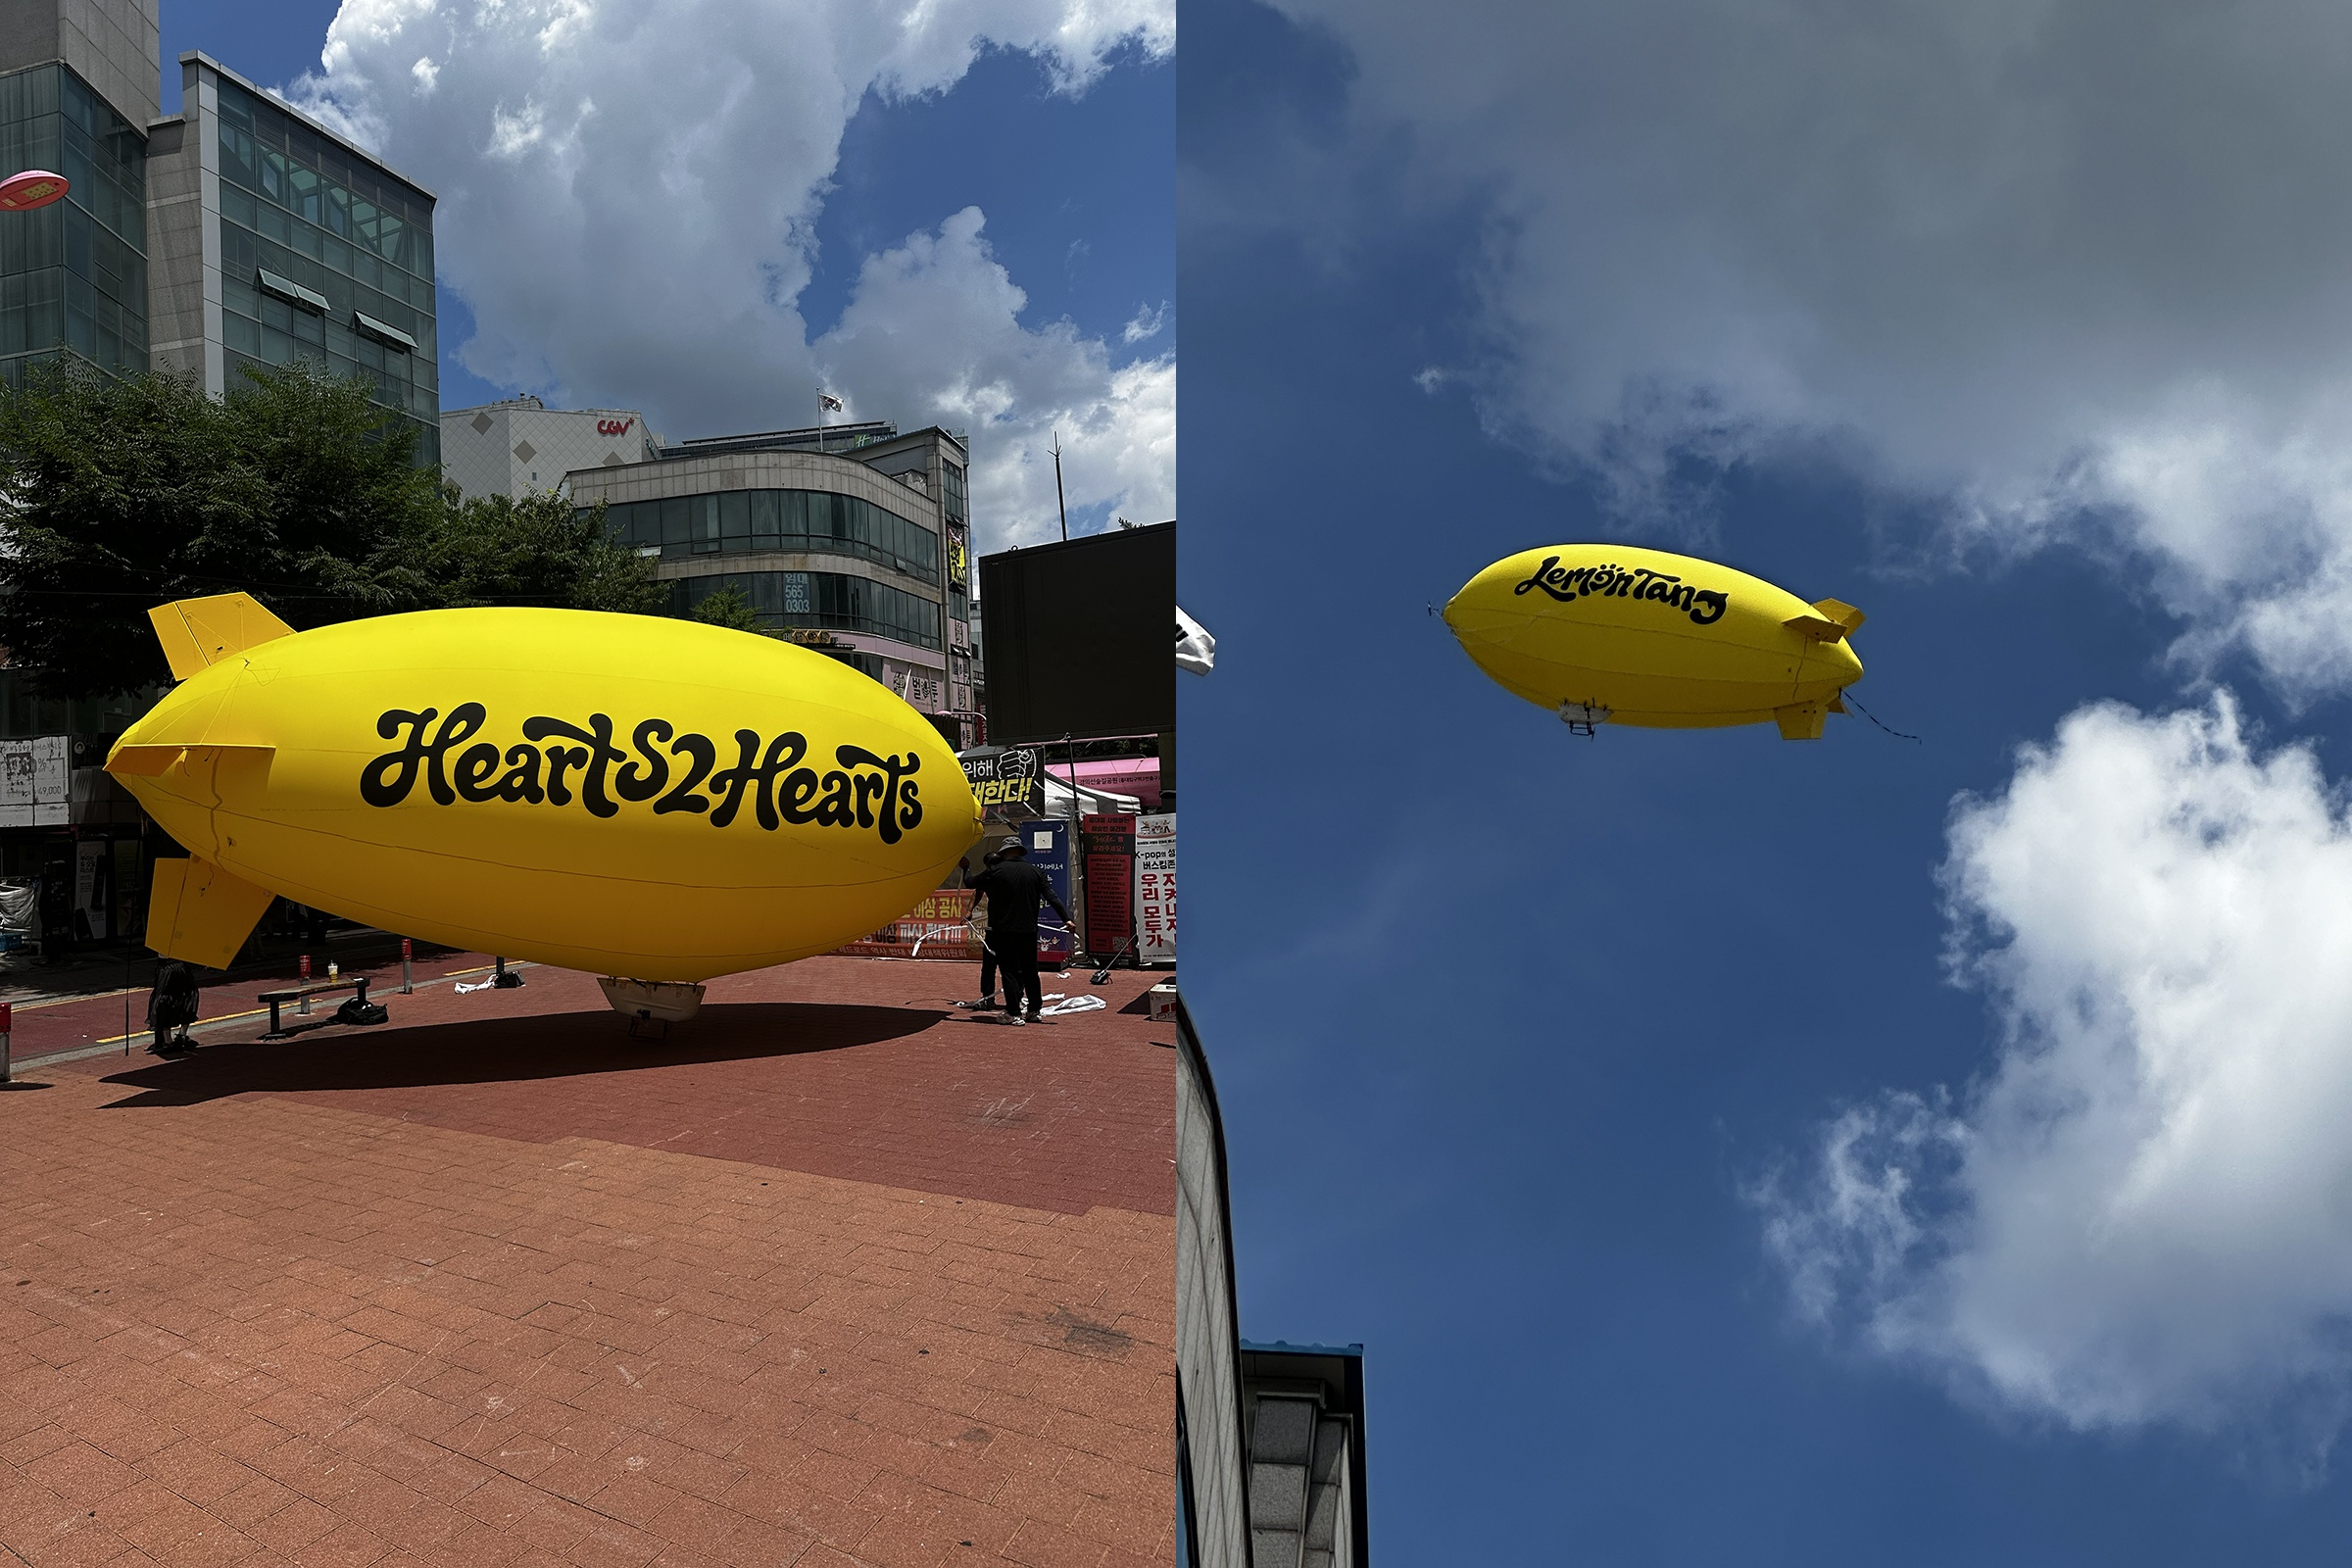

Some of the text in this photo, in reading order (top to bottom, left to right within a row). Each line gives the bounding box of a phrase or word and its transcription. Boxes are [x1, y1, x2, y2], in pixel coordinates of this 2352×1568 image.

[597, 419, 630, 436] CGV
[785, 572, 808, 584] 임대
[785, 584, 804, 599] 565
[1632, 567, 1730, 625] Tang
[786, 599, 809, 613] 0303
[961, 759, 994, 778] 위해
[913, 897, 962, 919] 이상 공사
[870, 947, 887, 956] 역사
[889, 948, 906, 956] 반대
